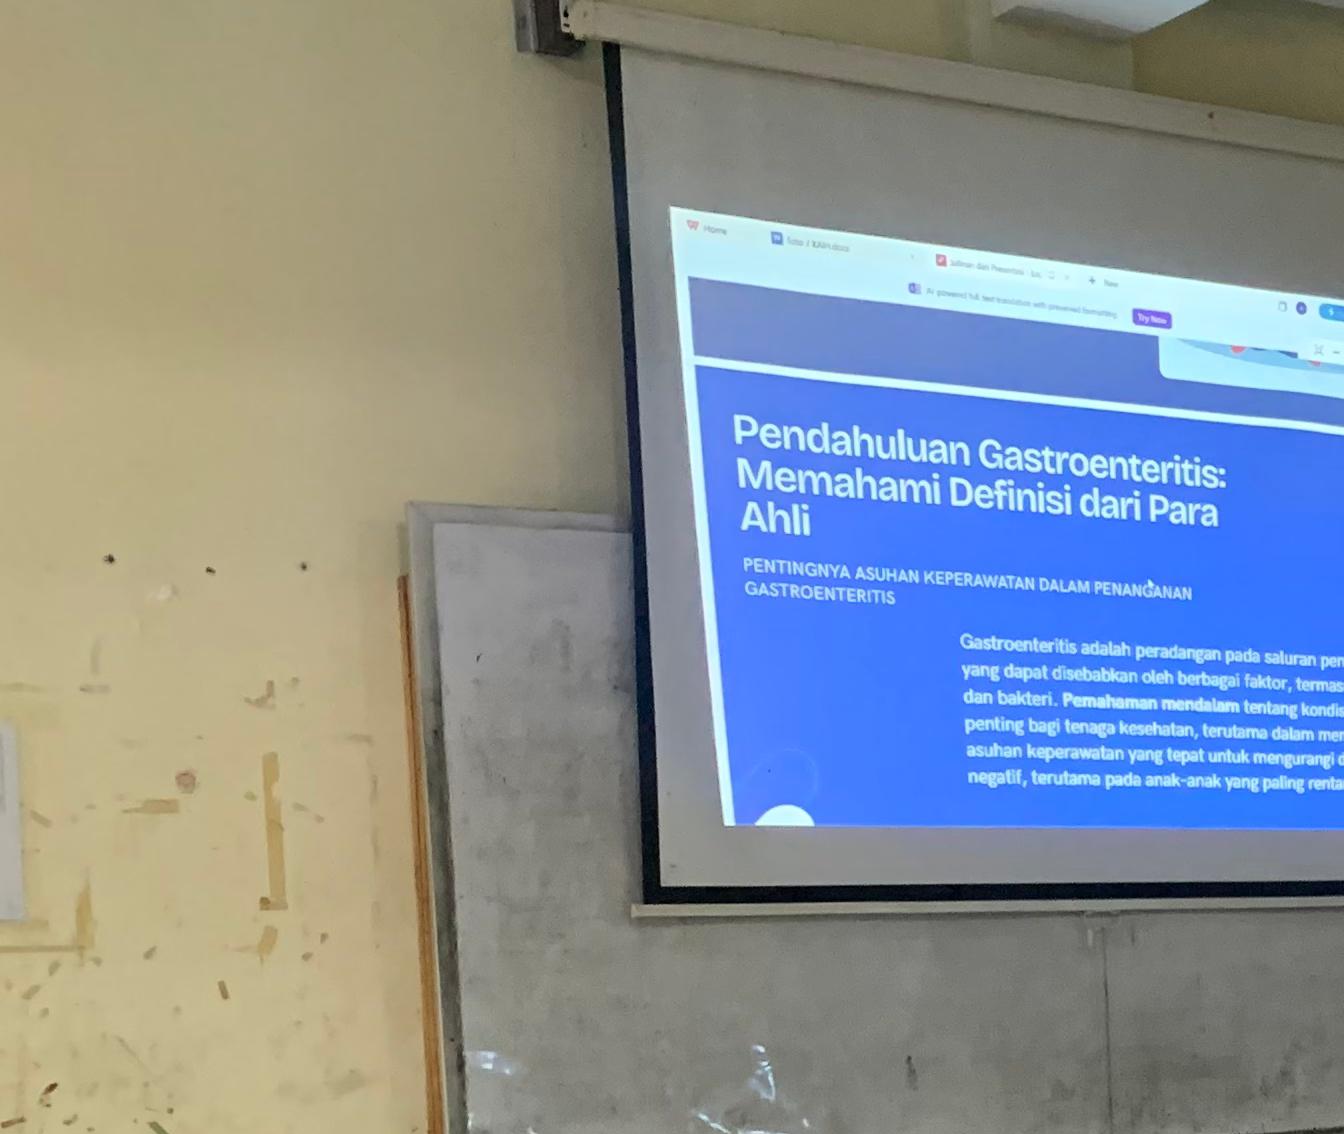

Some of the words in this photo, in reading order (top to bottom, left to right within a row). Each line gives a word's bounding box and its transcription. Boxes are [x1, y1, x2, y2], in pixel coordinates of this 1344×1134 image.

[1137, 312, 1150, 324] Try
[733, 413, 970, 466] Pendahuluan
[978, 438, 1227, 488] Gastroenteritis:
[736, 457, 941, 505] Memahami
[949, 476, 1072, 516] Definisi
[1080, 488, 1141, 522] dari
[1149, 495, 1219, 528] Para
[740, 501, 811, 536] Ahli
[743, 557, 851, 580] PENTINGNYA
[854, 566, 920, 585] ASUHAN
[923, 570, 1035, 592] KEPERAWATAN
[1039, 577, 1091, 595] DALAM
[1094, 580, 1193, 600] PENANGANAN
[744, 581, 896, 605] GASTROENTERITIS
[959, 633, 1078, 655] Gastroenteritis
[1081, 640, 1131, 657] adalah
[1135, 645, 1222, 665] peradangan
[1225, 648, 1261, 666] pada
[1264, 650, 1317, 667] saluran
[961, 663, 1000, 682] yang
[1004, 662, 1048, 683] dapat
[1052, 665, 1139, 684] disebabkan
[1142, 669, 1174, 685] oleh
[1177, 670, 1240, 691] berbagai
[1244, 673, 1294, 694] faktor,
[963, 688, 993, 705] dan
[998, 690, 1059, 707] bakteri.
[1062, 691, 1158, 710] Pemahaman
[1161, 697, 1240, 713] mendalam
[1243, 699, 1298, 719] tentang
[964, 716, 1025, 736] penting
[1028, 717, 1061, 738] bagi
[1064, 718, 1116, 739] tenaga
[1119, 720, 1199, 740] kesehatan,
[1202, 723, 1268, 740] terutama
[1271, 726, 1315, 742] dalam
[966, 742, 1022, 758] asuhan
[1026, 743, 1125, 763] keperawatan
[1128, 748, 1164, 766] yang
[1167, 747, 1205, 767] tepat
[1208, 749, 1250, 765] untuk
[1253, 751, 1335, 770] mengurangi
[967, 768, 1029, 789] negatif,
[1031, 770, 1101, 787] terutama
[1105, 771, 1142, 791] pada
[1145, 772, 1222, 790] anak-anak
[1225, 775, 1260, 794] yang
[1263, 775, 1305, 794] paling
